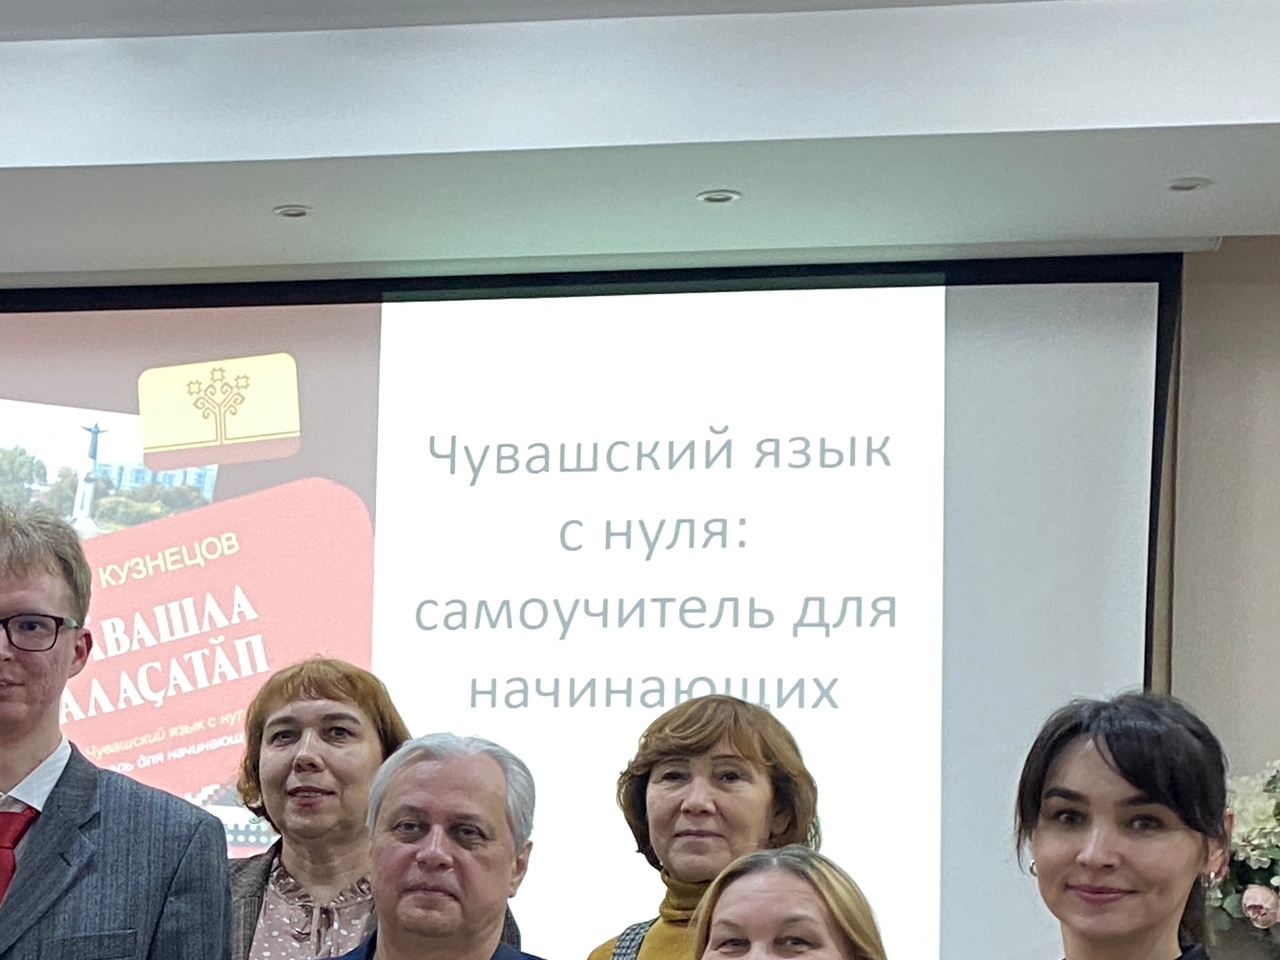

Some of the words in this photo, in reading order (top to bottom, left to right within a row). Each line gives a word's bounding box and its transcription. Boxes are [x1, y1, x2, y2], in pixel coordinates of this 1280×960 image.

[429, 424, 733, 487] Чувашский
[754, 435, 891, 469] язык
[98, 532, 240, 589] КУЗНЕЦОВ
[559, 519, 584, 552] с
[605, 517, 746, 562] нуля:
[83, 584, 259, 662] ВАШЛА
[415, 596, 775, 641] самоучитель
[792, 596, 896, 638] для
[59, 634, 270, 725] АЛАҪАТӐП
[470, 676, 840, 709] начинающих
[85, 727, 166, 761] Чувашский
[168, 720, 205, 739] язык
[207, 716, 217, 728] с
[220, 708, 245, 727] нул
[167, 732, 245, 761] начинающ
